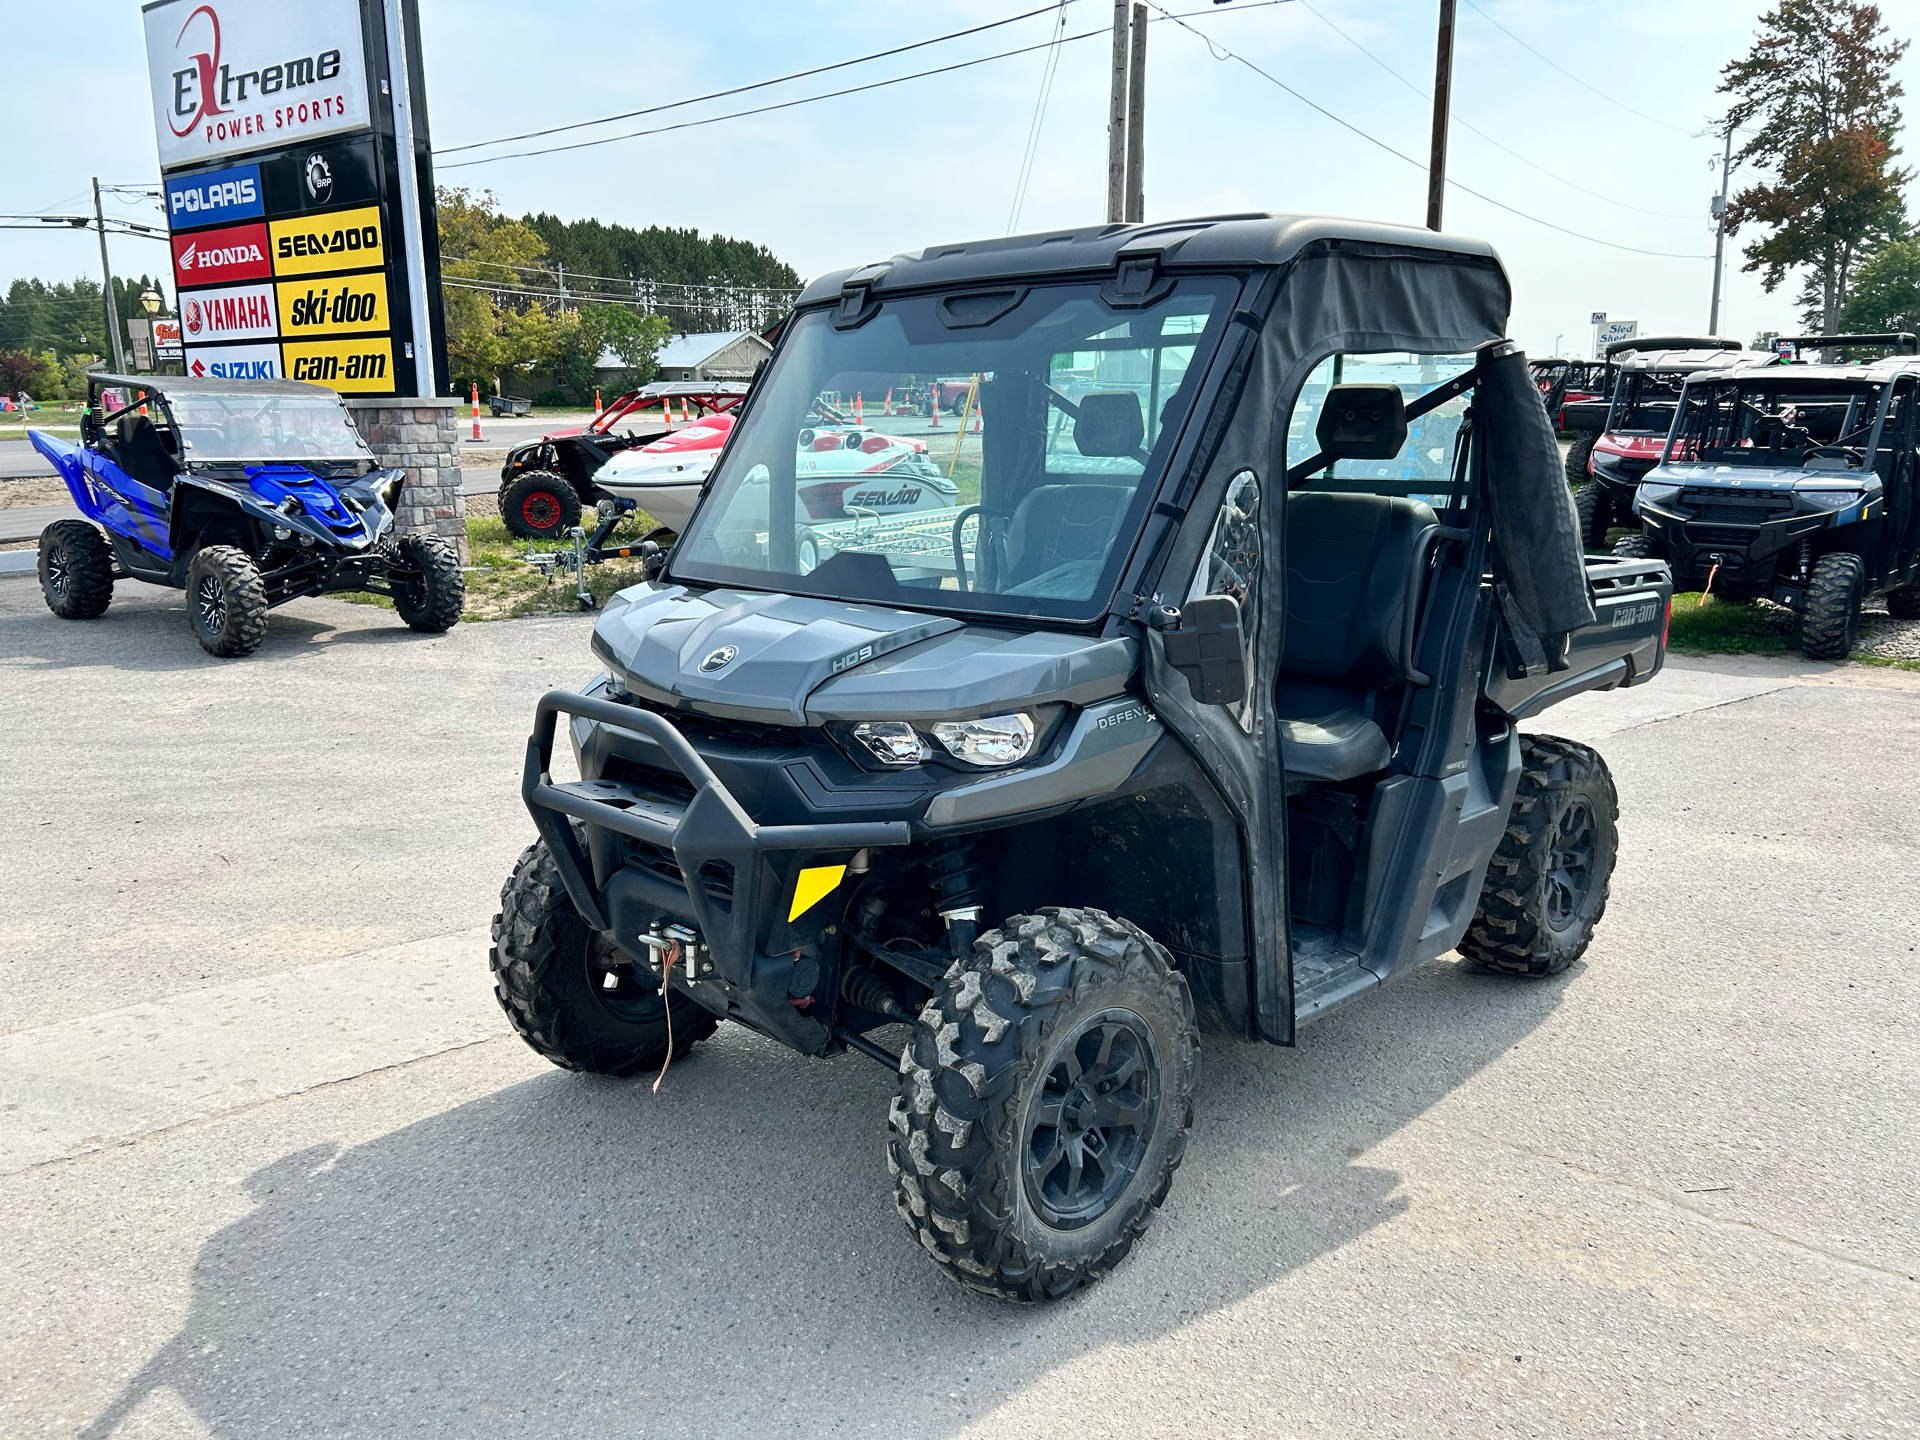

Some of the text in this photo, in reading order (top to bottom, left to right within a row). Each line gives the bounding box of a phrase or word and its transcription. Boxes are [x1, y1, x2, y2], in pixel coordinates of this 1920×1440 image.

[205, 95, 346, 144] POWER SPORTS
[316, 177, 332, 188] BRP
[170, 179, 256, 215] POLARIS
[197, 244, 264, 268] HONDA
[203, 294, 272, 331] YAMAHA
[1609, 324, 1634, 333] Sled
[210, 360, 275, 380] SUZUKI
[832, 645, 873, 673] HD9
